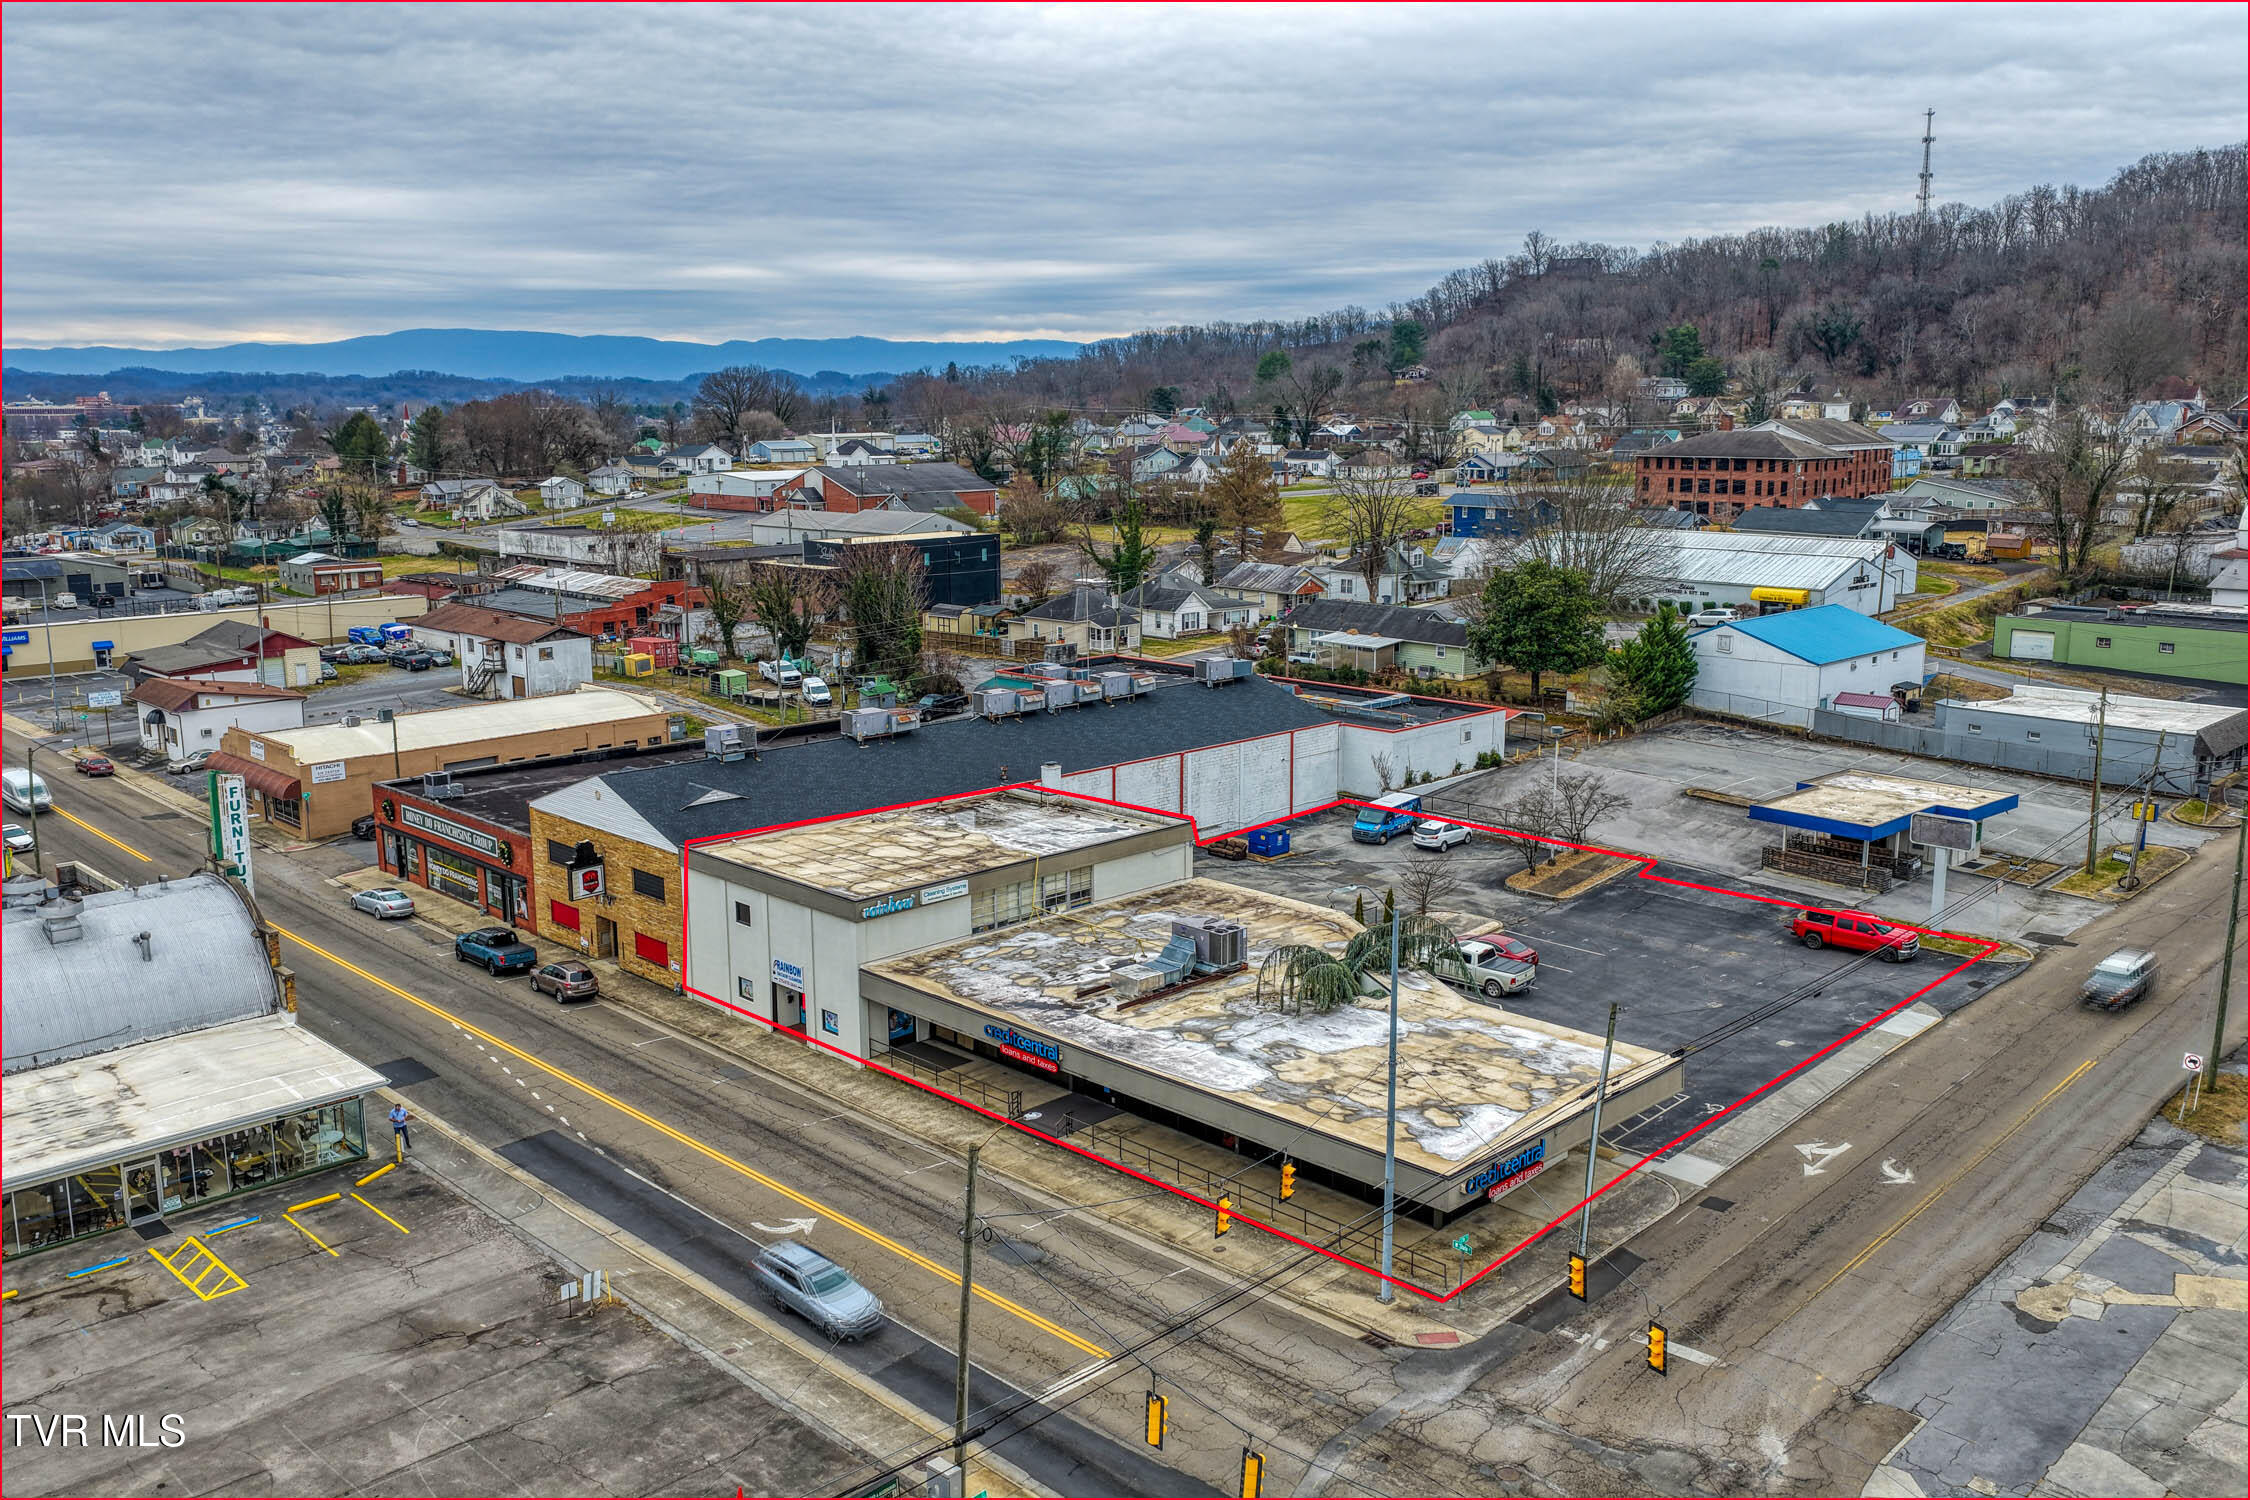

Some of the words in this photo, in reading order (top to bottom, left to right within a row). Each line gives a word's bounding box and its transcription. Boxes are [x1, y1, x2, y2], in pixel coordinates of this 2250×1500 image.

[405, 810, 424, 825] HONEY
[424, 816, 433, 829] DO
[433, 820, 472, 843] FRANCHISING
[473, 833, 493, 850] GROUP
[863, 895, 914, 919] rainbow
[777, 960, 802, 977] RAINBOW
[984, 1024, 1059, 1062] creditcentral
[1002, 1044, 1020, 1059] loans
[1022, 1053, 1035, 1064] and
[1037, 1059, 1057, 1072] taxes
[1466, 1138, 1546, 1195] creditcentral
[1488, 1181, 1509, 1198] loans
[1509, 1173, 1524, 1187] and
[1524, 1163, 1543, 1179] taxes
